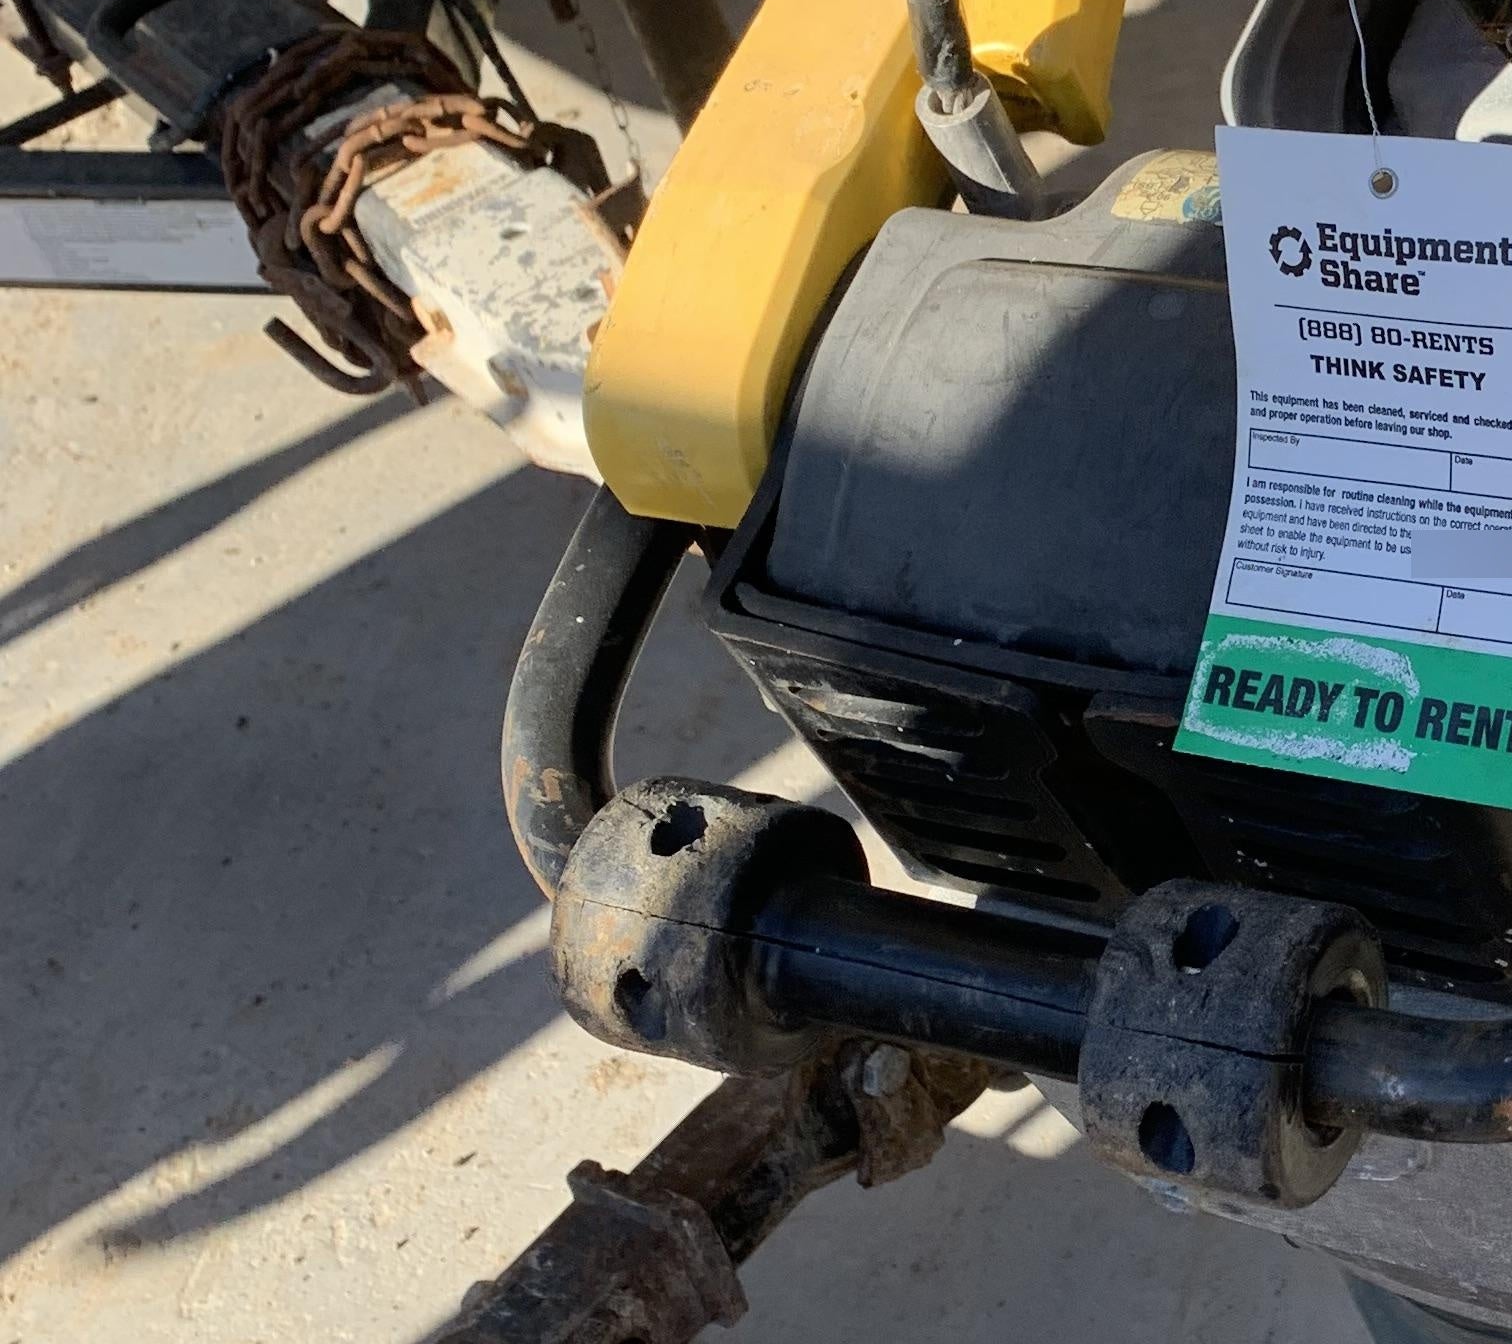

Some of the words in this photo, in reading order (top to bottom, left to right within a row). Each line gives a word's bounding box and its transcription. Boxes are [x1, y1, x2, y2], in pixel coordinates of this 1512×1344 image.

[1298, 317, 1363, 346] (888)
[1371, 328, 1495, 357] 80-RENTS
[1310, 354, 1387, 382] THINK
[1393, 364, 1487, 392] SAFETY
[1250, 390, 1268, 402] This
[1272, 394, 1319, 407] equipment
[1323, 399, 1338, 410] has
[1343, 401, 1364, 413] been
[1368, 404, 1405, 418] cleaned,
[1410, 410, 1448, 422] serviced
[1453, 415, 1469, 424] and
[1474, 416, 1512, 430] checked
[1250, 407, 1266, 417] and
[1269, 409, 1297, 421] proper
[1300, 414, 1342, 425] operation
[1345, 416, 1372, 429] before
[1375, 420, 1407, 435] leaving
[1410, 427, 1425, 435] our
[1428, 427, 1452, 440] shop.
[1290, 436, 1299, 446] By
[1454, 456, 1473, 465] Date
[1247, 477, 1250, 487] I
[1252, 479, 1266, 489] am
[1269, 482, 1321, 496] responsible
[1323, 486, 1336, 497] for
[1342, 490, 1374, 502] routine
[1377, 494, 1415, 508] cleaning
[1419, 498, 1443, 510] while
[1447, 502, 1461, 513] the
[1243, 509, 1287, 523] equipment
[1289, 515, 1304, 525] and
[1307, 517, 1327, 528] have
[1329, 519, 1349, 531] been
[1352, 523, 1386, 535] directed
[1389, 526, 1397, 537] to
[1244, 494, 1296, 508] possession.
[1305, 500, 1324, 512] have
[1328, 504, 1363, 516] received
[1367, 508, 1415, 523] instructions
[1419, 517, 1430, 525] on
[1434, 516, 1447, 527] the
[1450, 519, 1481, 530] correct
[1237, 539, 1269, 552] without
[1271, 543, 1286, 554] risk
[1290, 546, 1297, 556] to
[1300, 547, 1326, 561] injury.
[1240, 523, 1263, 534] sheet
[1267, 526, 1274, 537] to
[1278, 528, 1306, 541] enable
[1310, 531, 1323, 543] the
[1326, 535, 1371, 550] equipment
[1374, 540, 1382, 551] to
[1386, 541, 1396, 553] be
[1235, 561, 1274, 573] Customer
[1276, 567, 1313, 579] Signature
[1446, 589, 1465, 599] Date
[1203, 664, 1346, 723] READY
[1353, 685, 1406, 734] TO
